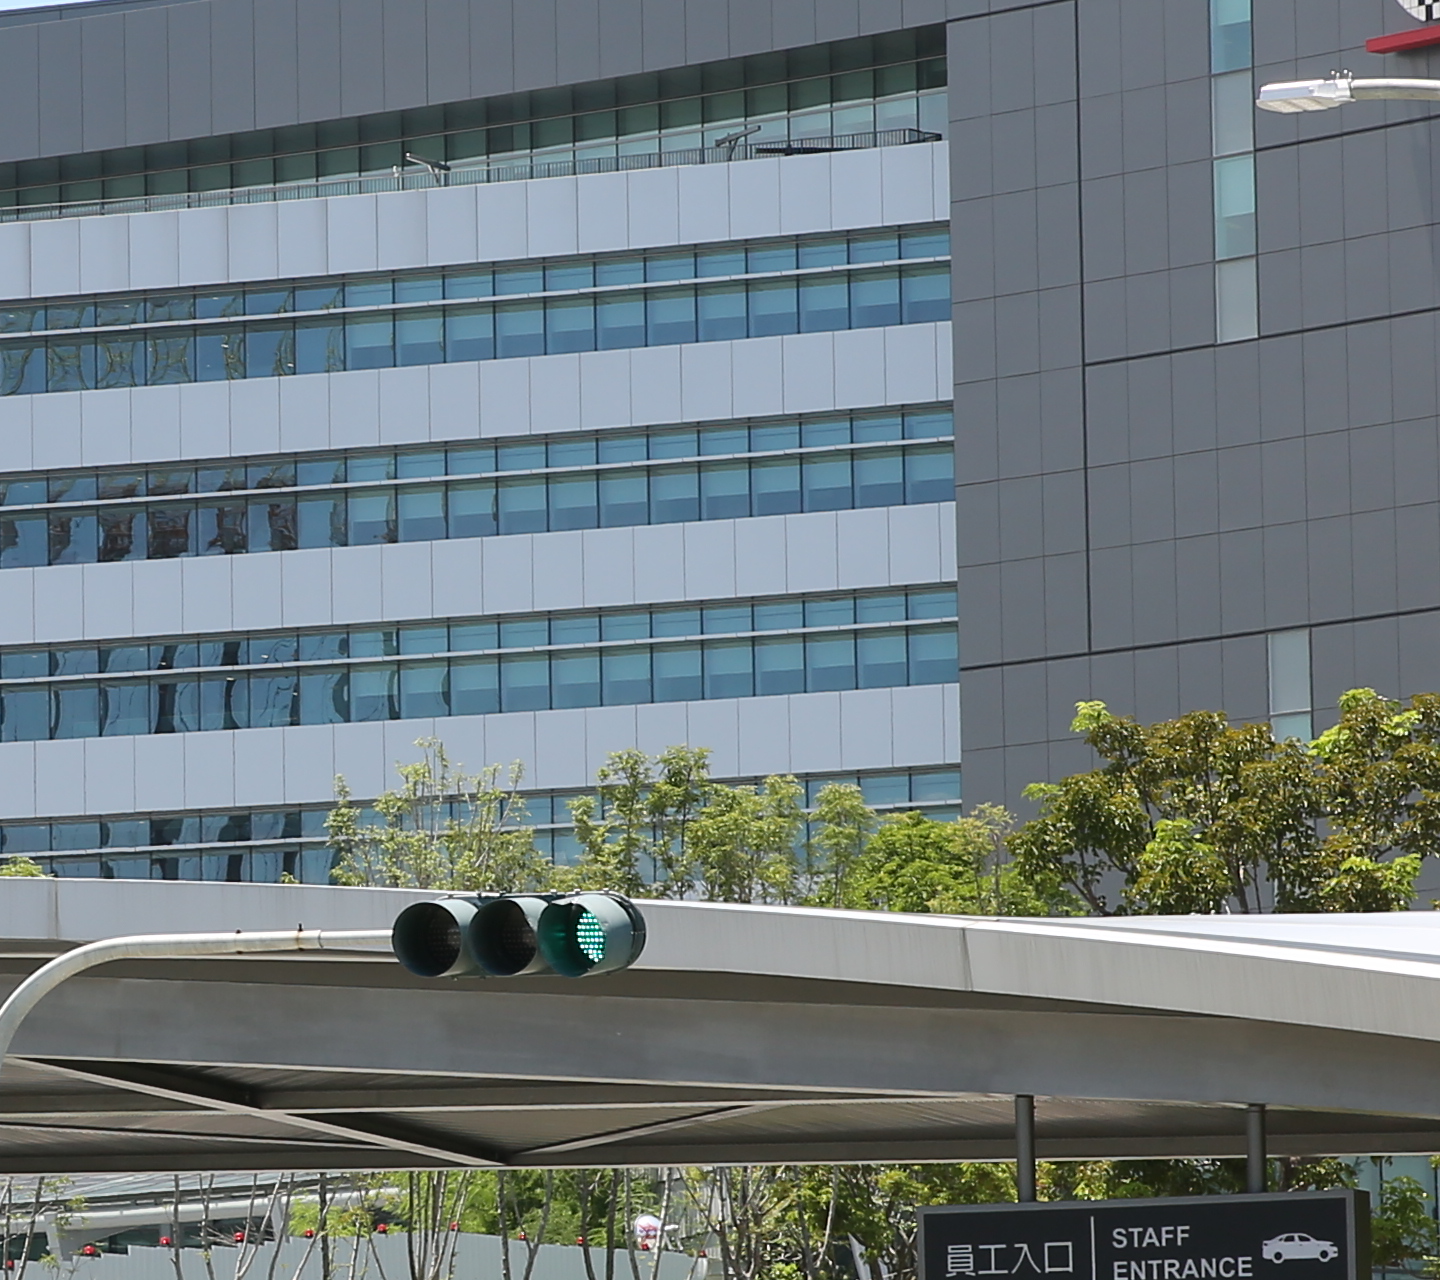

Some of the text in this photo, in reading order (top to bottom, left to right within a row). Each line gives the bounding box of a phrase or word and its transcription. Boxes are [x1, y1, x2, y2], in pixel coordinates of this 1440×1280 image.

[1112, 1225, 1190, 1249] STAFF
[946, 1240, 1074, 1278] 員工入口
